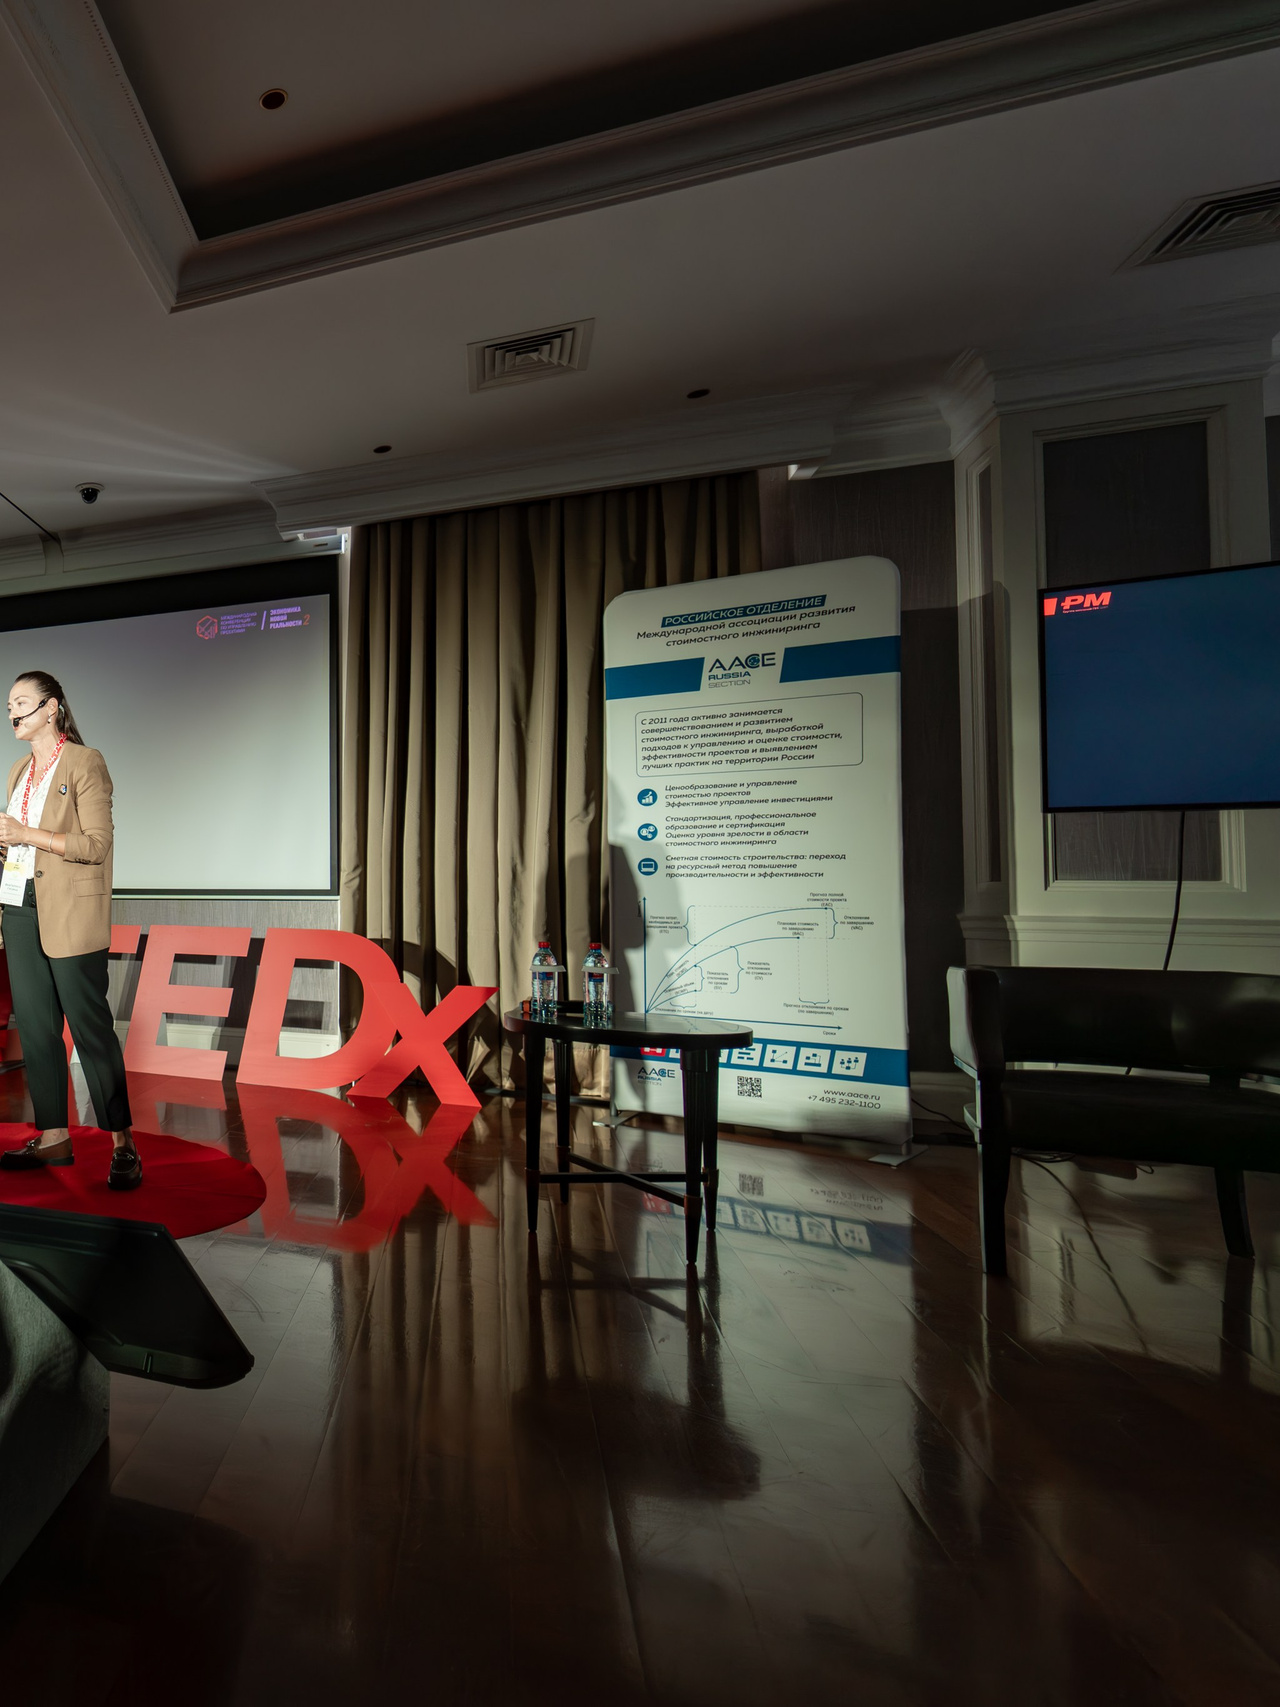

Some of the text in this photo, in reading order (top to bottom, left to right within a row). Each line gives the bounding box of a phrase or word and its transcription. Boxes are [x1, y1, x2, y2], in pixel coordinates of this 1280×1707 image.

[1061, 592, 1111, 609] PM
[665, 597, 822, 626] РОССИЙСКОЕ ОТДЕЛЕНИЕ
[303, 614, 310, 625] 2
[637, 606, 856, 639] Международной ассоциации развития
[666, 622, 820, 646] стоимостного инжиниринга
[708, 652, 776, 672] AACE
[708, 671, 751, 680] RUSSIA
[708, 679, 750, 688] SECTION
[691, 713, 727, 721] активно
[729, 709, 782, 718] занимается
[641, 722, 733, 734] совершенствованием
[743, 718, 793, 727] развитием
[641, 724, 824, 743] стоимостного инжиниринга, выработкой
[642, 744, 681, 752] подходов
[691, 740, 745, 750] управлению
[756, 737, 788, 745] оценке
[791, 734, 842, 742] стоимости,
[642, 751, 706, 761] эффективности
[708, 749, 749, 757] проектов
[760, 744, 817, 752] выявлением
[675, 760, 709, 768] практик
[725, 757, 778, 765] территории
[665, 783, 737, 791] Ценообразование
[746, 780, 797, 788] управление
[665, 800, 718, 808] Эффективное
[720, 798, 769, 806] управление
[666, 813, 816, 823] Стандартизация, профессиональное
[726, 821, 785, 829] сертификация
[677, 863, 720, 871] ресурсный
[758, 871, 824, 879] эффективности
[638, 1067, 675, 1078] AACE
[824, 1090, 880, 1100] www.aace.ru
[838, 1099, 881, 1109] 232-1100
